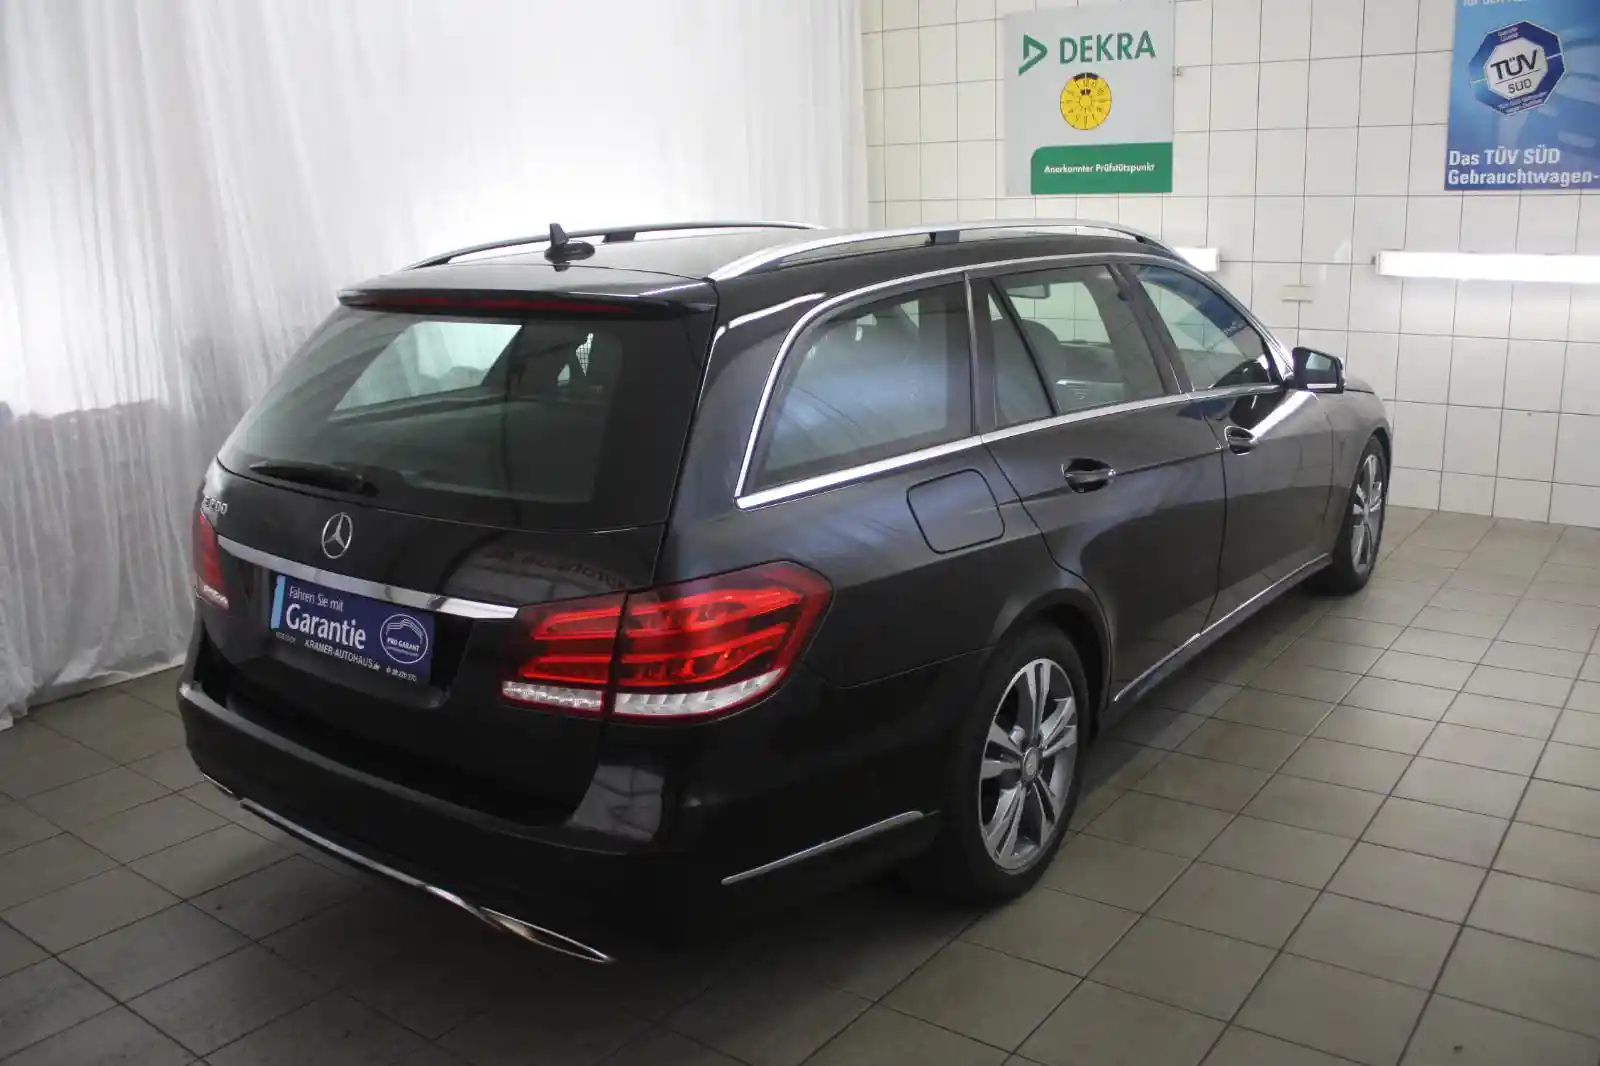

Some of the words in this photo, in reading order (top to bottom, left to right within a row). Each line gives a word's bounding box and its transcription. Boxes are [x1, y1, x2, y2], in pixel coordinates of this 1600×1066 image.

[1060, 30, 1156, 64] DEKRA
[1490, 50, 1538, 80] TÜV
[1448, 150, 1480, 166] Das
[1483, 146, 1520, 165] TÜV
[1523, 144, 1561, 165] SÜD
[1448, 168, 1600, 187] Gebrauchtwagen-
[289, 586, 315, 604] Fahren
[317, 593, 329, 608] Sie
[330, 597, 344, 613] mit
[286, 603, 366, 650] Garantie
[398, 640, 420, 652] GARANT
